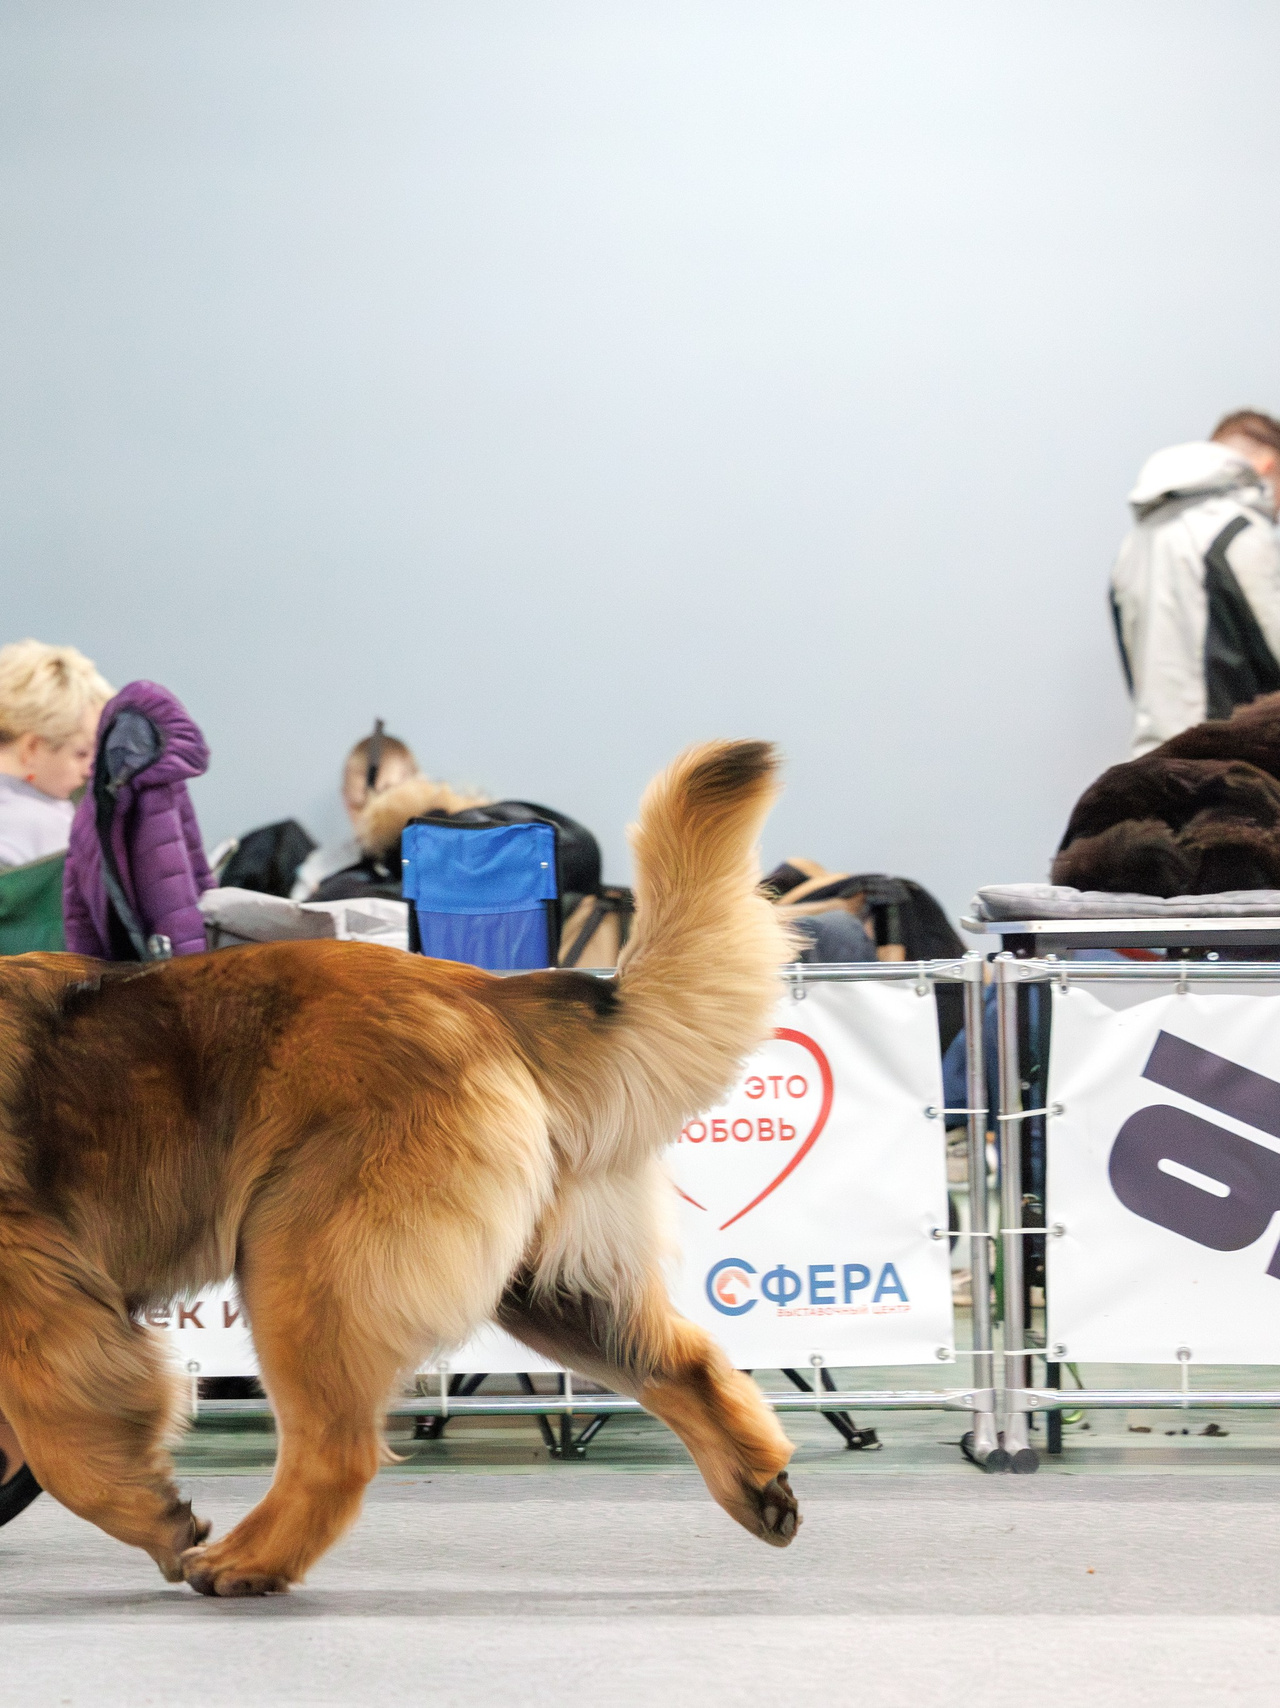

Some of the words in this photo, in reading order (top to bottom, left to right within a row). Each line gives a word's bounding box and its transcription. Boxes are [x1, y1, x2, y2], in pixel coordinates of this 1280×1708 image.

[744, 1074, 809, 1100] ЭТО
[675, 1116, 797, 1144] ЮБОВЬ
[705, 1257, 910, 1317] СФЕРА
